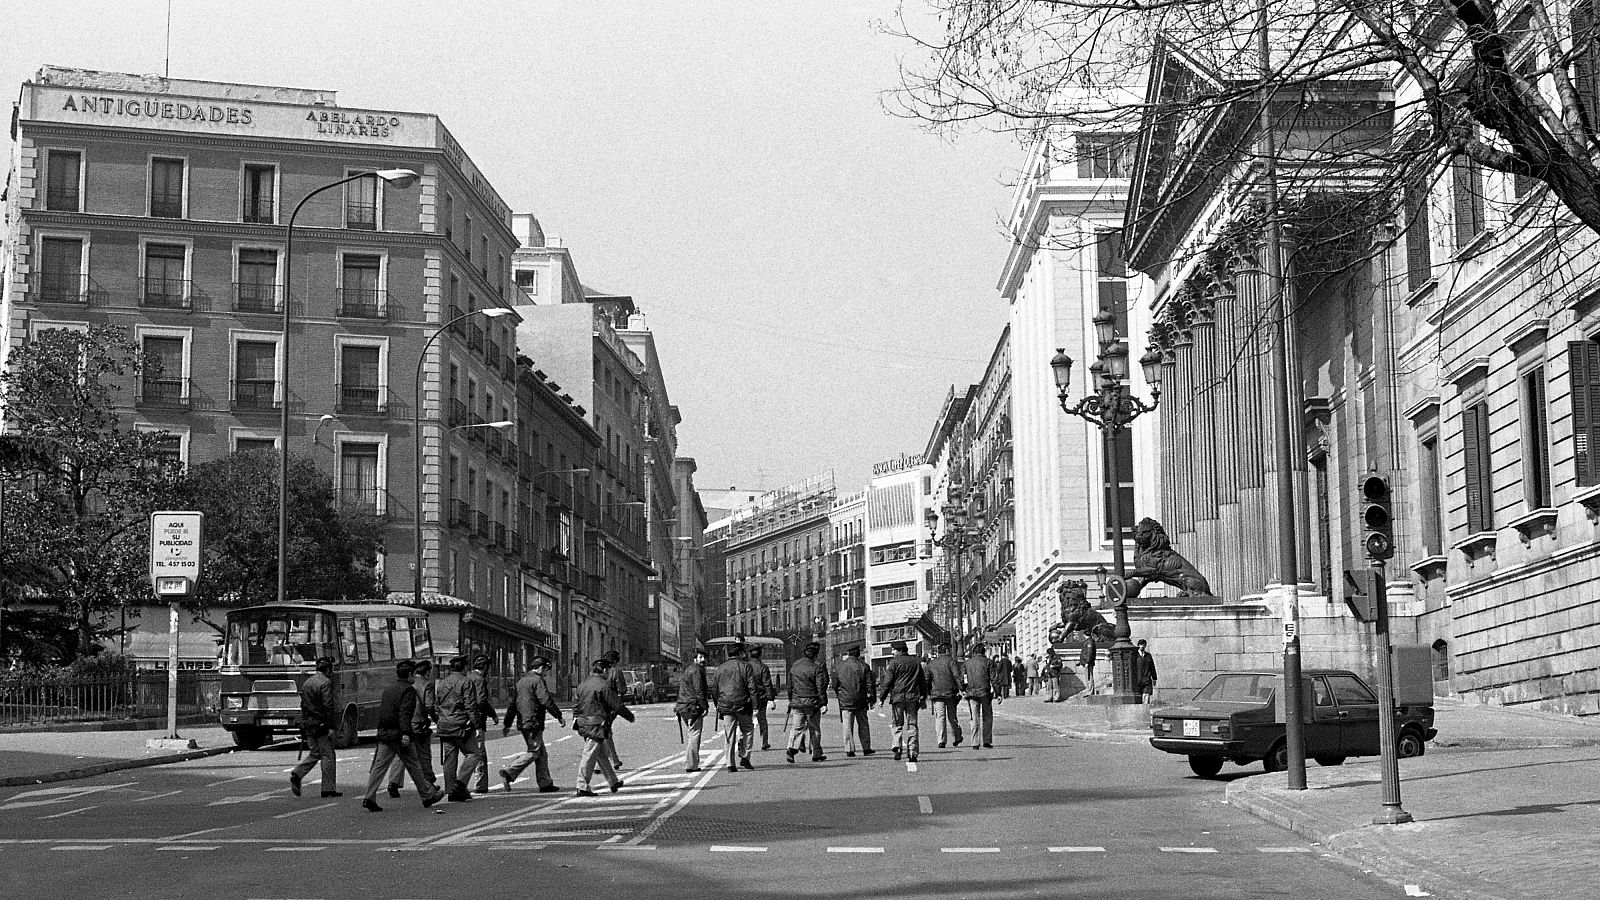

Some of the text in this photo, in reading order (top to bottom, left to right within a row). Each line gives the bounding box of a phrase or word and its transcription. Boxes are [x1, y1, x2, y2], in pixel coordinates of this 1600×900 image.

[62, 94, 252, 124] ANTIGÜEDADES
[305, 110, 400, 127] ABELARDO
[317, 122, 390, 137] LINARES
[155, 661, 213, 670] LIARES
